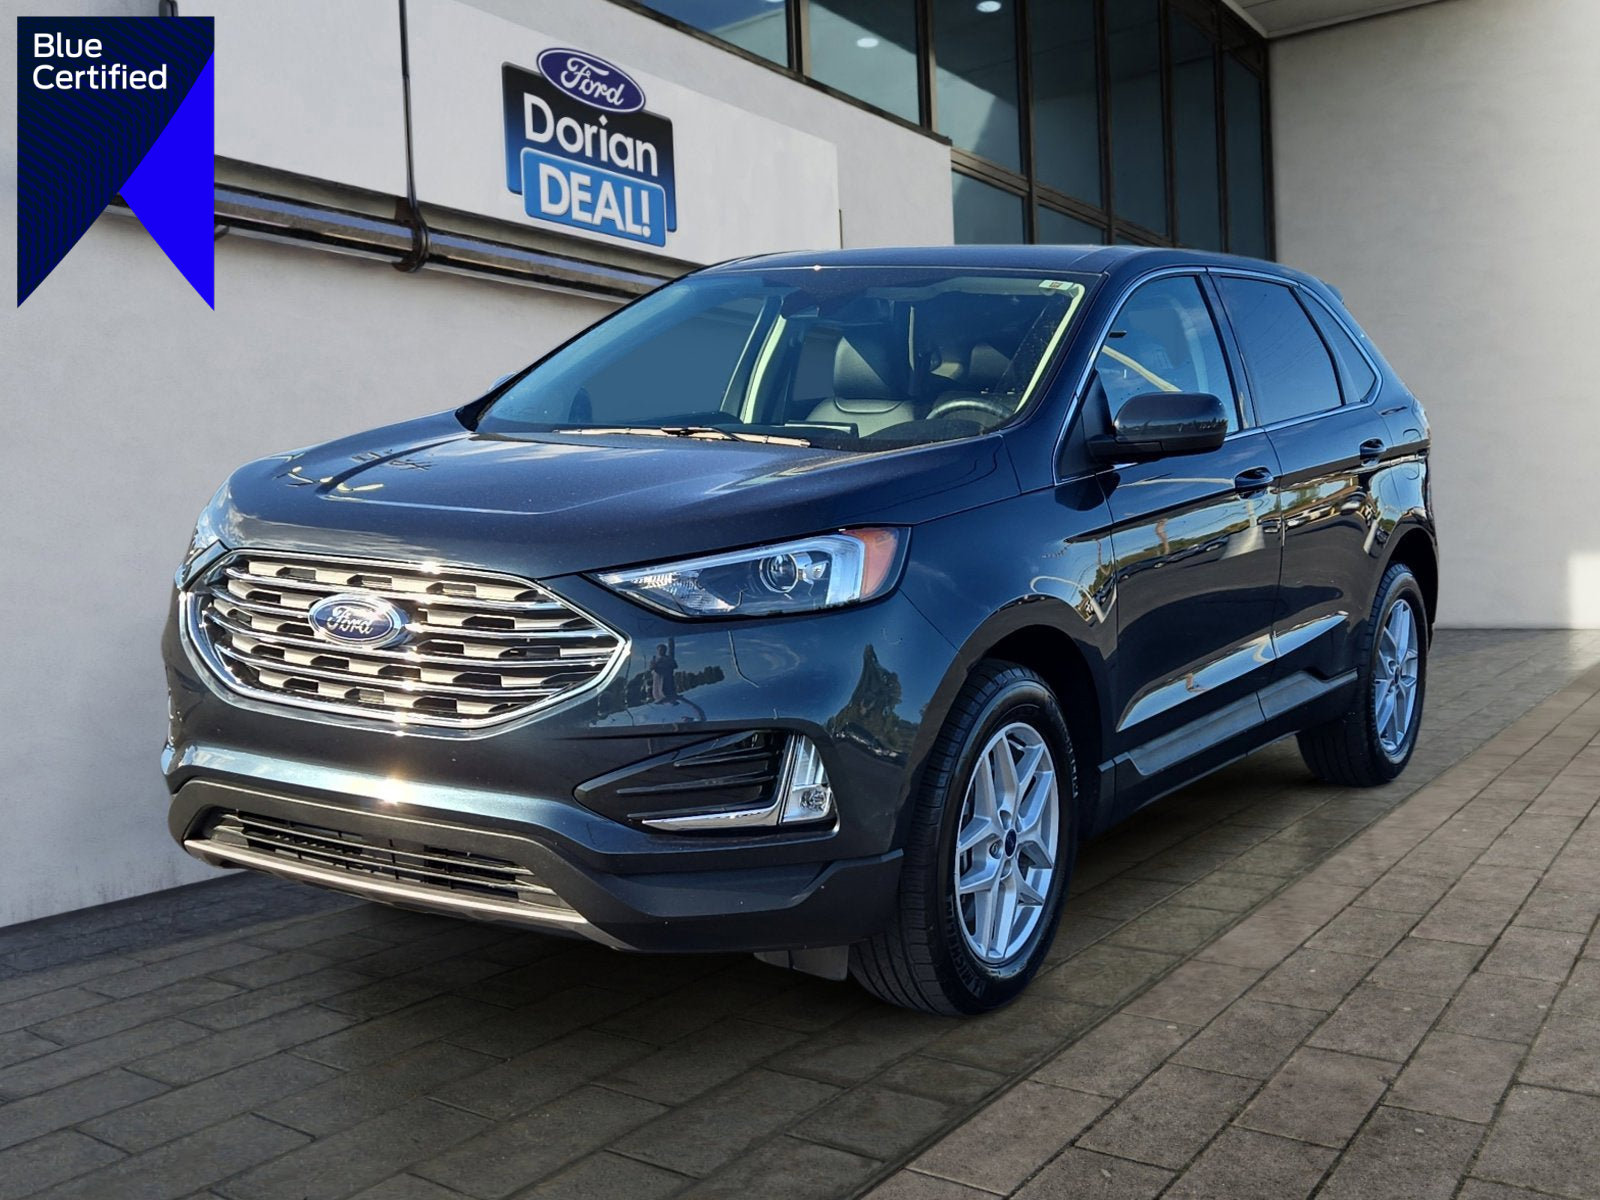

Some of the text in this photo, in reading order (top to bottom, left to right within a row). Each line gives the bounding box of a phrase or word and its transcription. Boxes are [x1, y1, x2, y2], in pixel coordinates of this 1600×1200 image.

[560, 57, 624, 106] Ford
[523, 92, 659, 177] Dorian
[539, 163, 651, 238] DEAL!
[327, 604, 375, 634] Ford
